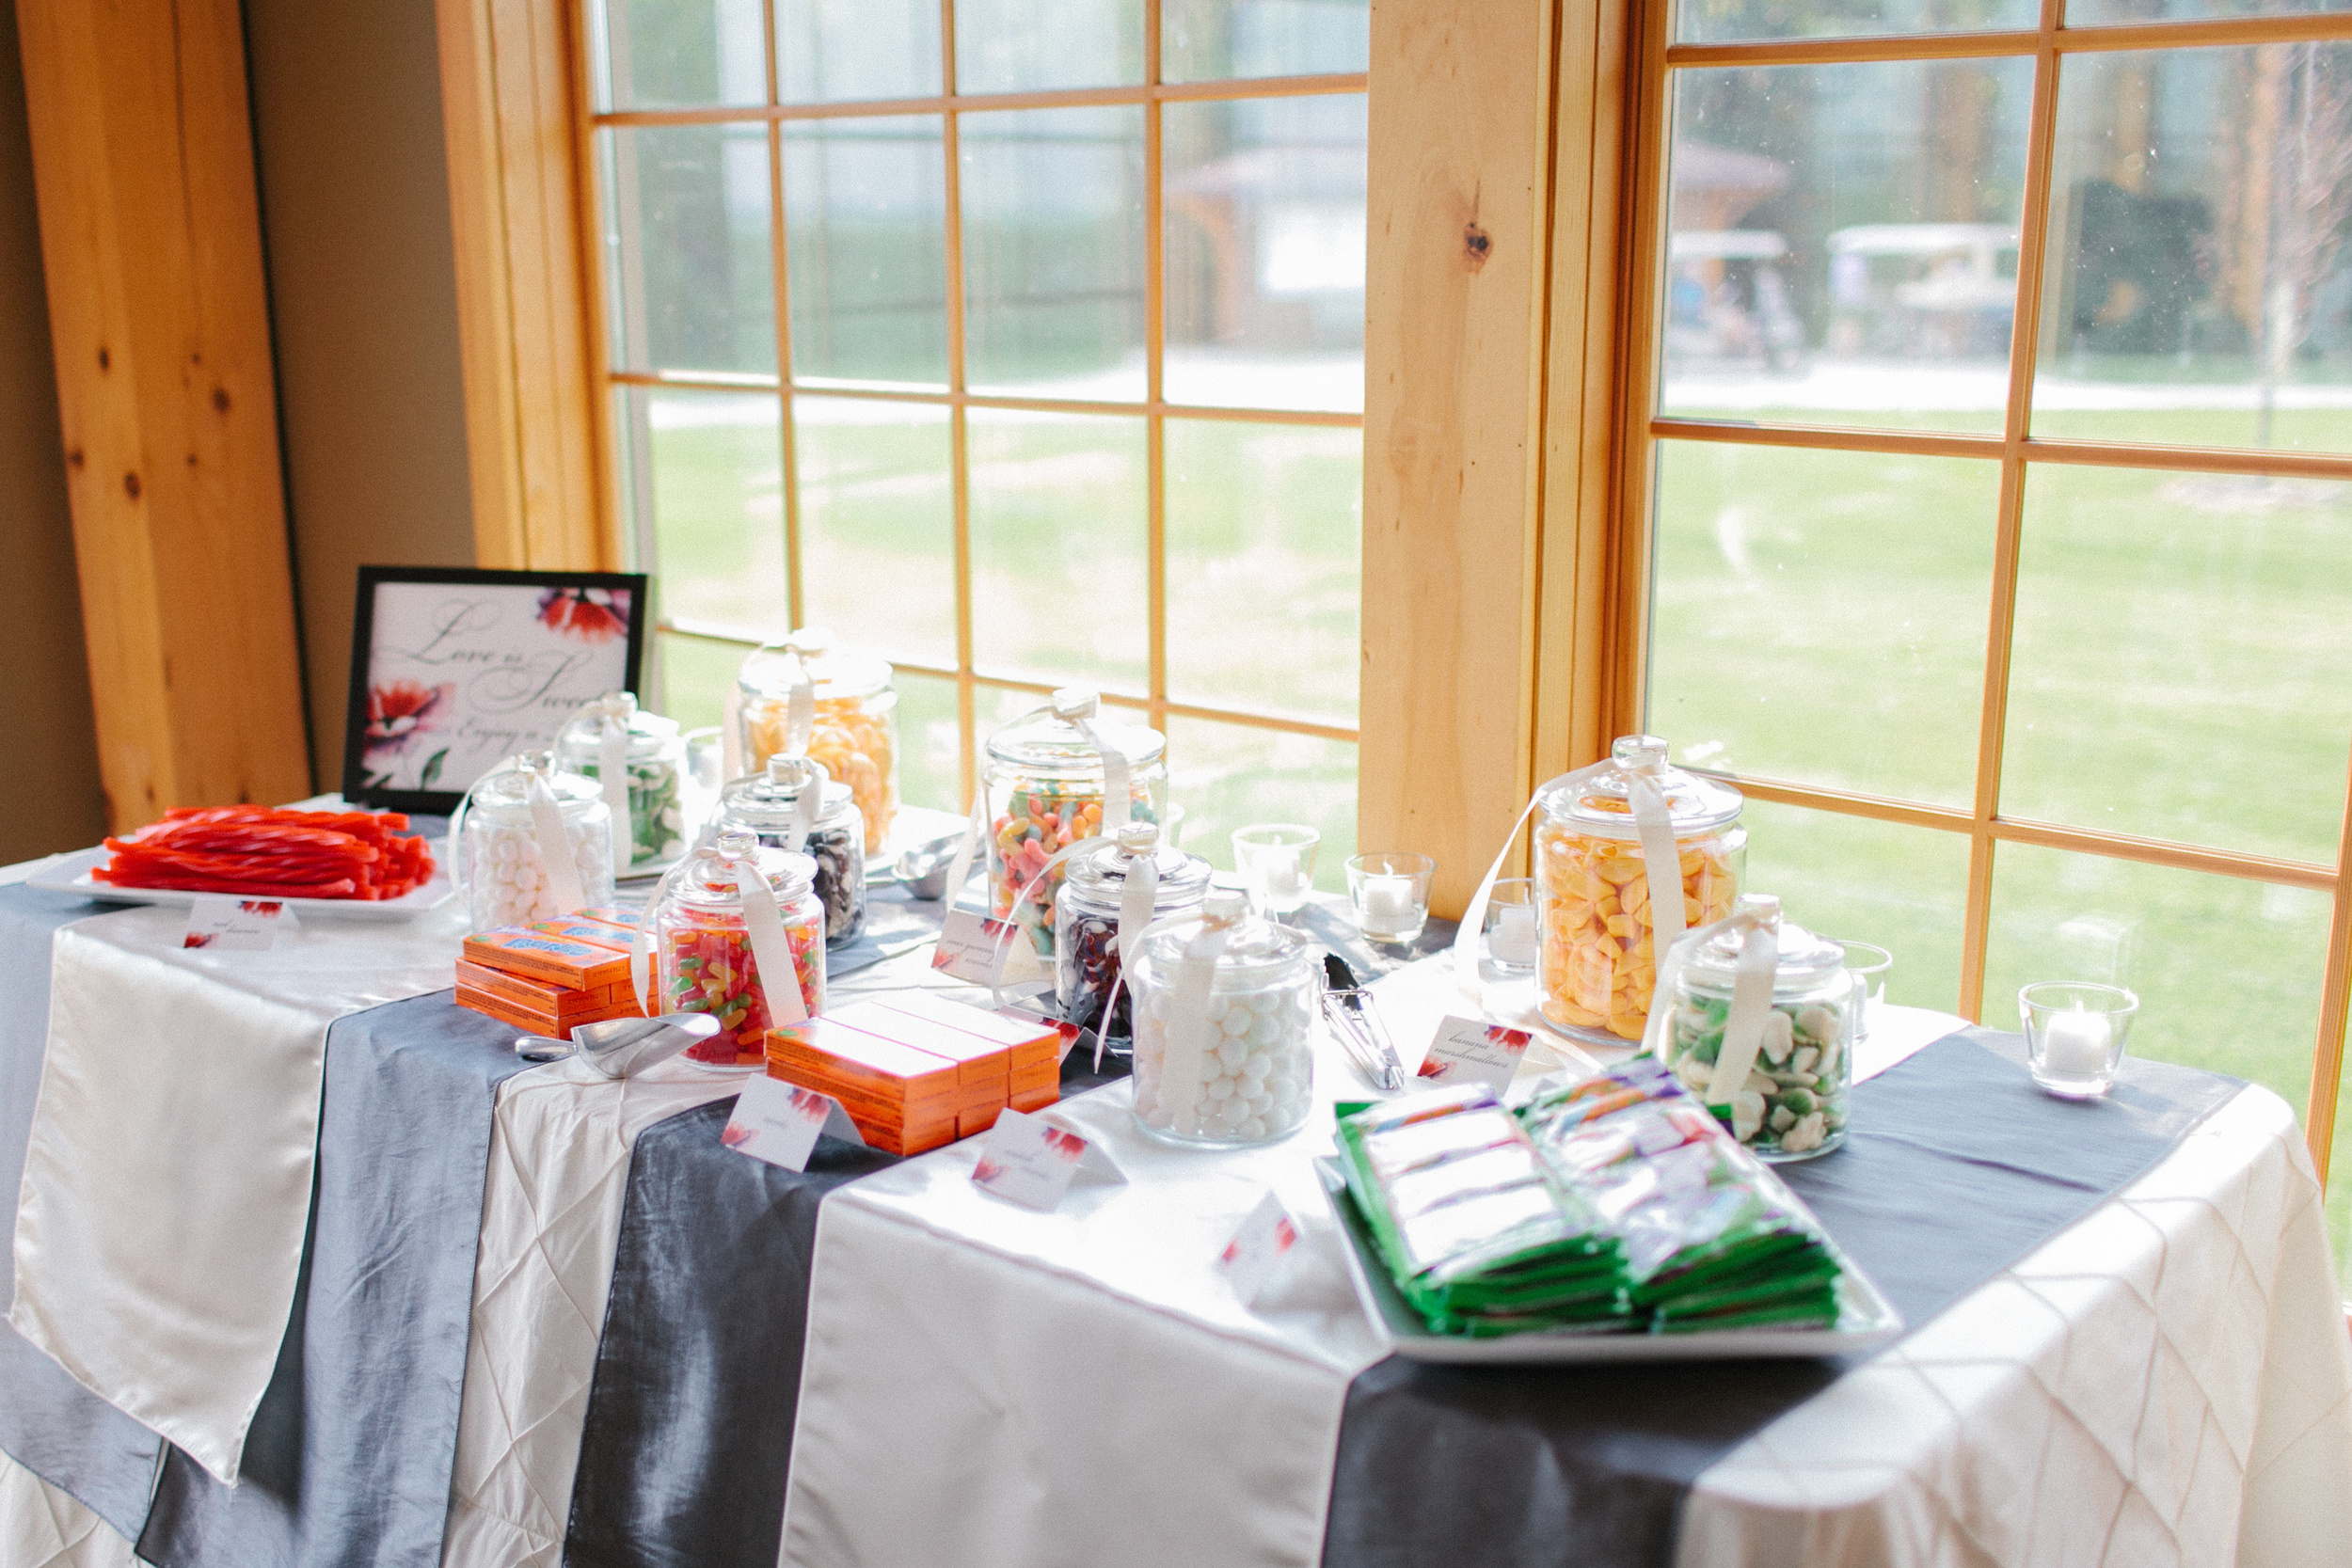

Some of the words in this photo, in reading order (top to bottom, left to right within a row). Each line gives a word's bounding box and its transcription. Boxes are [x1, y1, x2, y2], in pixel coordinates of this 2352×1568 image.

[374, 599, 500, 665] Love
[503, 647, 523, 664] is
[1448, 1030, 1489, 1051] banana
[1434, 1047, 1510, 1069] marshmallows
